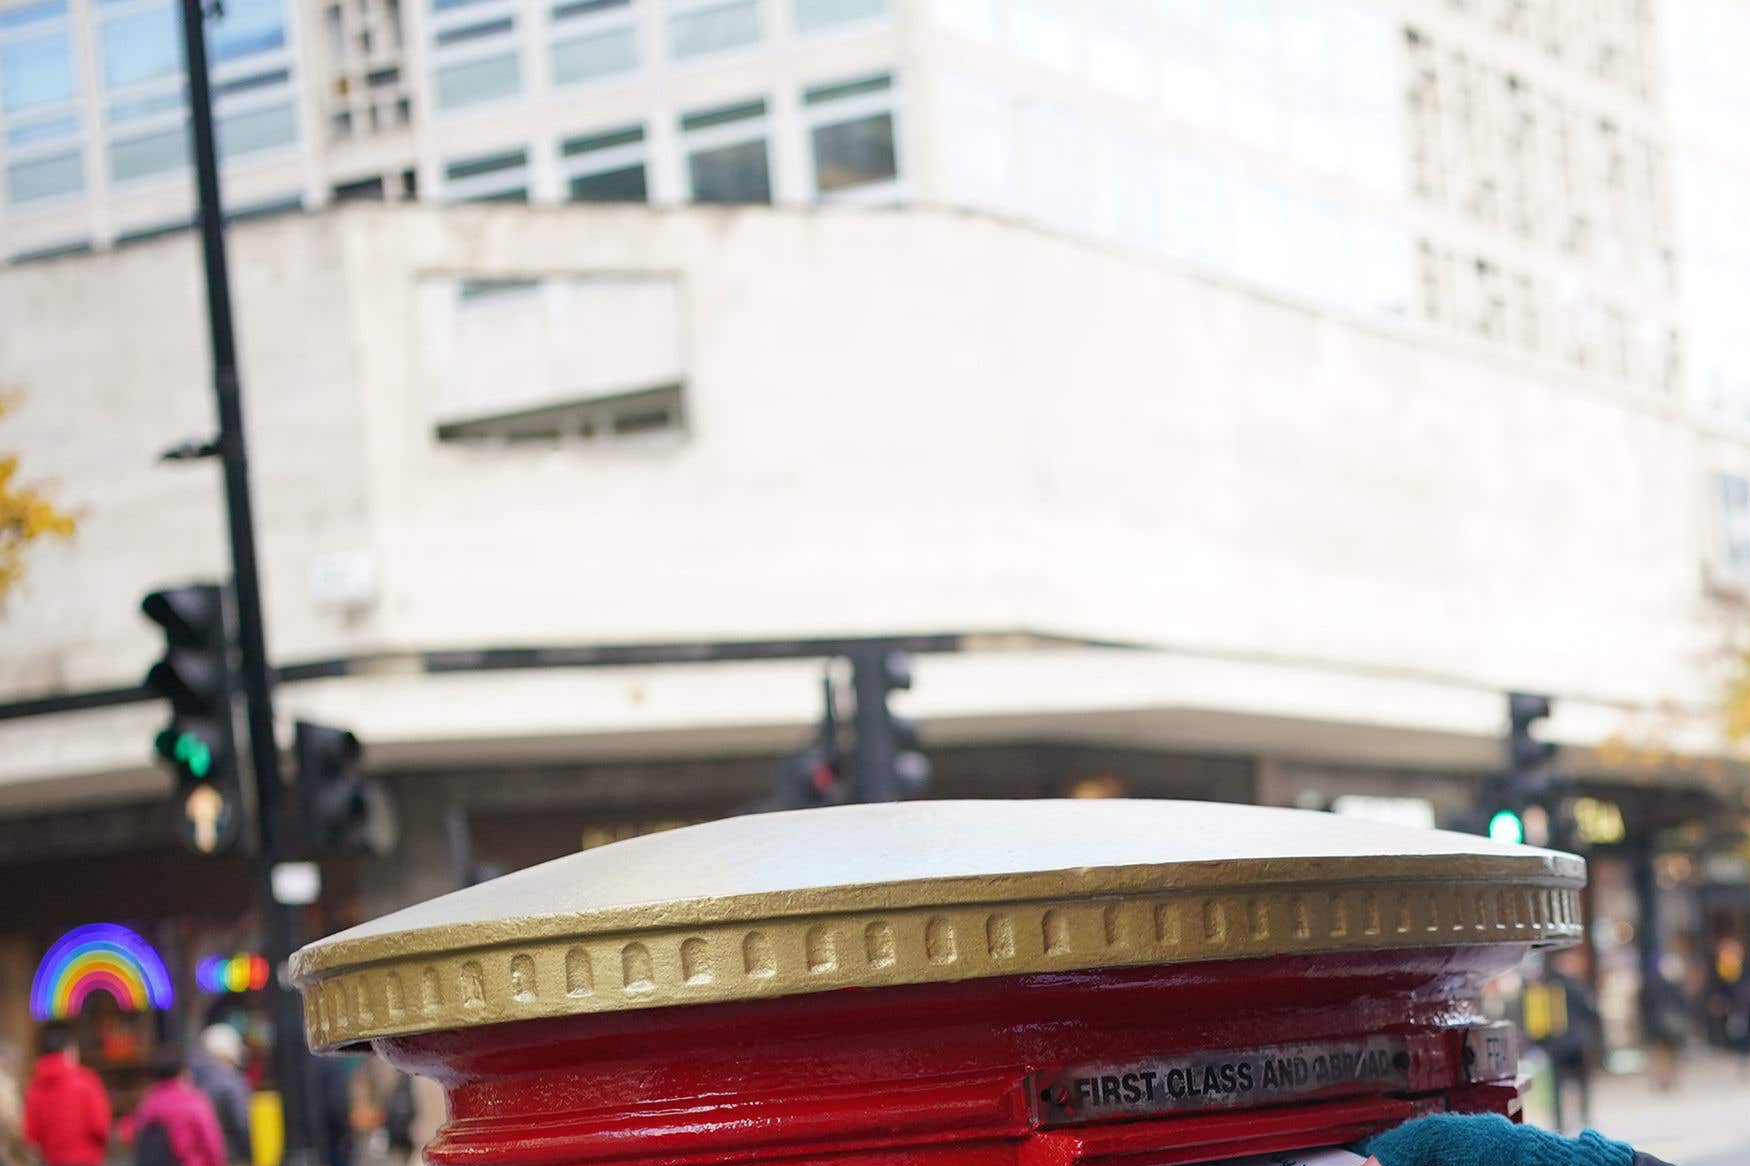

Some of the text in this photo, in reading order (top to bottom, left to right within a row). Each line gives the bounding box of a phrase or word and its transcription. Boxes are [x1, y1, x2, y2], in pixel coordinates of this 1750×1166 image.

[1074, 1072, 1157, 1105] FIRST
[1167, 1061, 1254, 1099] CLASS
[1263, 1054, 1308, 1089] AND
